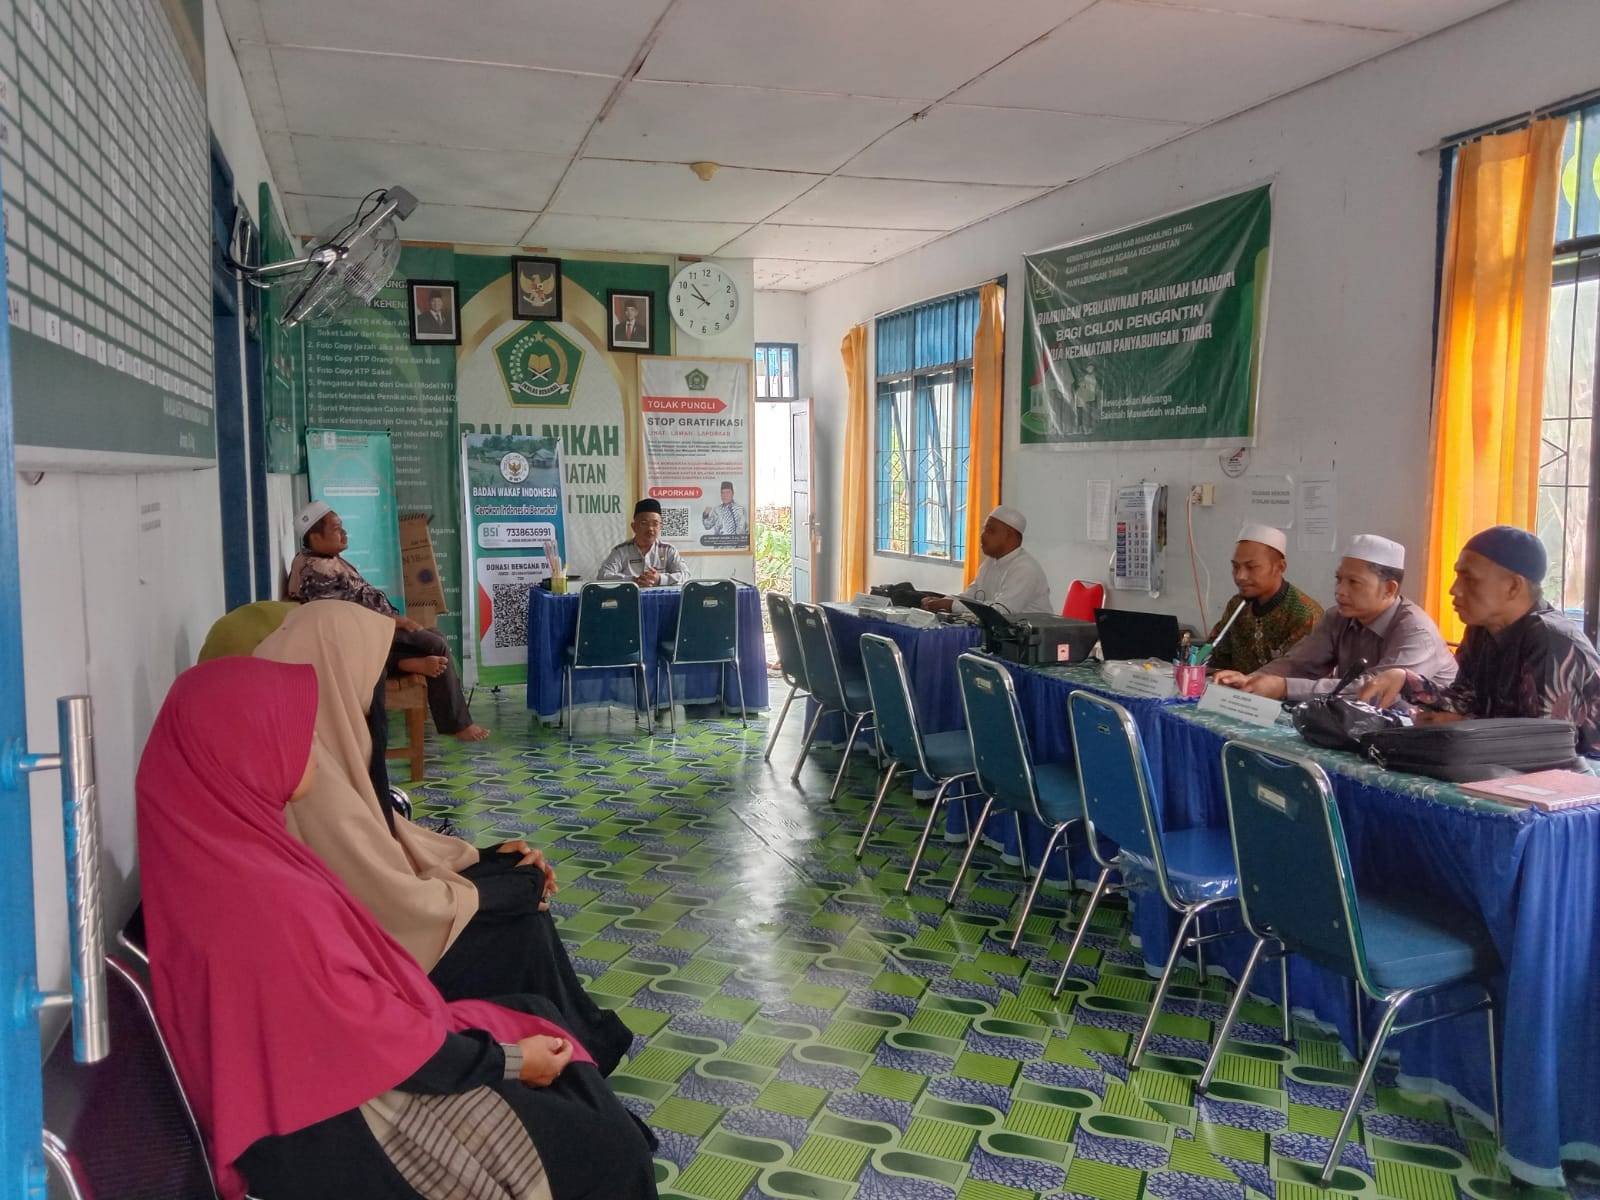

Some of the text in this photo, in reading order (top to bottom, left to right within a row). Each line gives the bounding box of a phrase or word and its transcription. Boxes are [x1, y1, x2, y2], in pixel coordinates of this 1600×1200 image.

[688, 272, 697, 280] 11
[702, 269, 711, 277] 12
[718, 274, 721, 282] 1
[679, 281, 688, 289] 10
[726, 285, 731, 293] 2
[676, 295, 681, 303] 9
[1082, 293, 1140, 318] PERKAWINAN
[1141, 281, 1190, 306] PRANIKAH
[1191, 271, 1236, 296] MANDIRI
[729, 300, 735, 308] 3
[679, 308, 684, 316] 8
[689, 320, 694, 328] 7
[715, 322, 720, 330] 5
[1056, 303, 1205, 342] BAGI CALON PENGANTIN
[702, 325, 707, 334] 6
[1065, 339, 1112, 360] KECAMATAN
[1113, 329, 1180, 353] PANYABUNGAN
[1182, 323, 1213, 343] TIMUR
[648, 400, 716, 410] TOLAK PUNGLI
[1175, 404, 1207, 415] Rahmah
[647, 417, 743, 427] STOP GRATIFIKASI
[473, 487, 557, 497] BADAN WAKAF INDONESIA
[653, 488, 694, 497] LAPORKAN
[576, 494, 622, 514] TIMUR
[482, 527, 551, 537] BSI 7338636991
